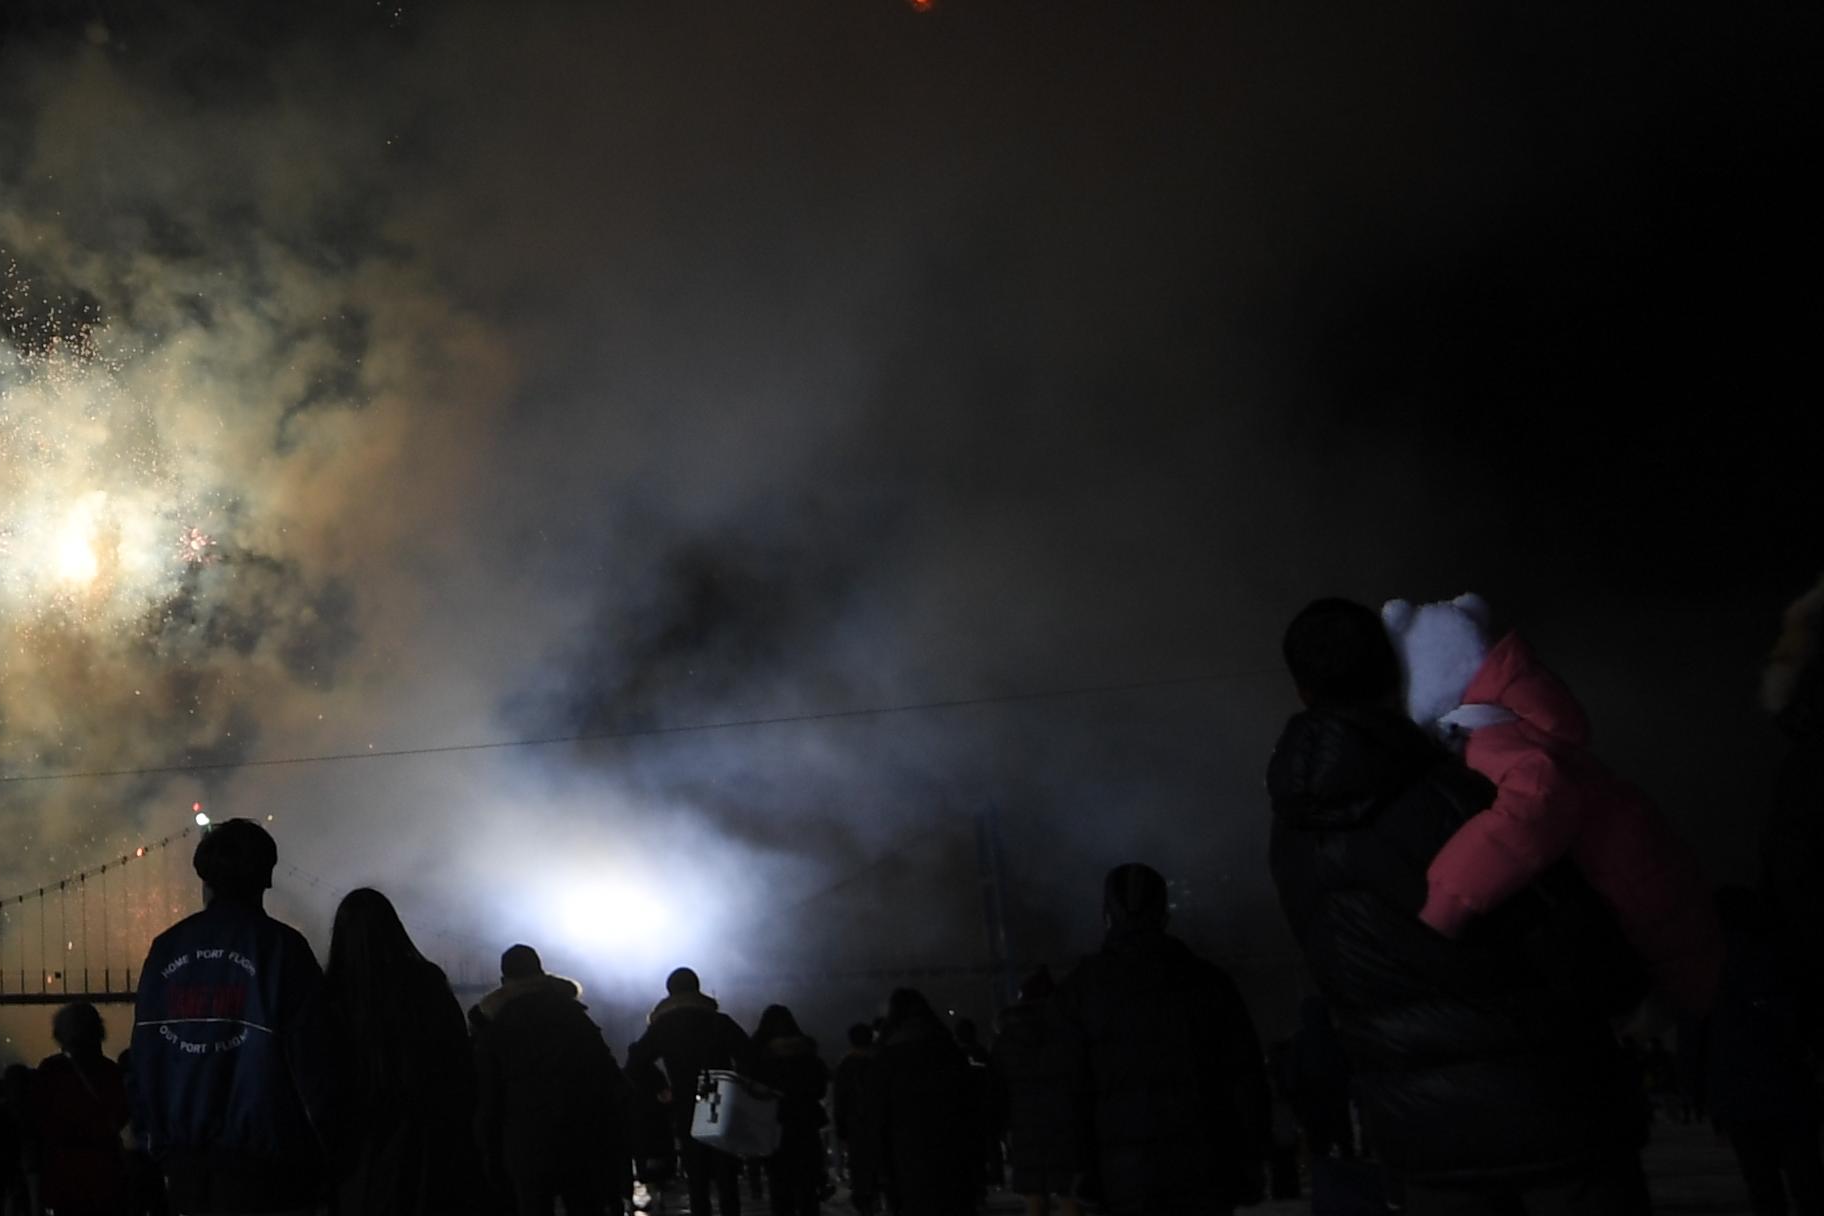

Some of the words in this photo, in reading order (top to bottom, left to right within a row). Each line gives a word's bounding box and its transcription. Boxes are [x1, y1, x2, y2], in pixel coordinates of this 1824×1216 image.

[160, 954, 190, 979] HOME
[196, 949, 225, 960] PORT
[159, 1024, 179, 1045] OUT
[179, 1040, 208, 1054] PORT
